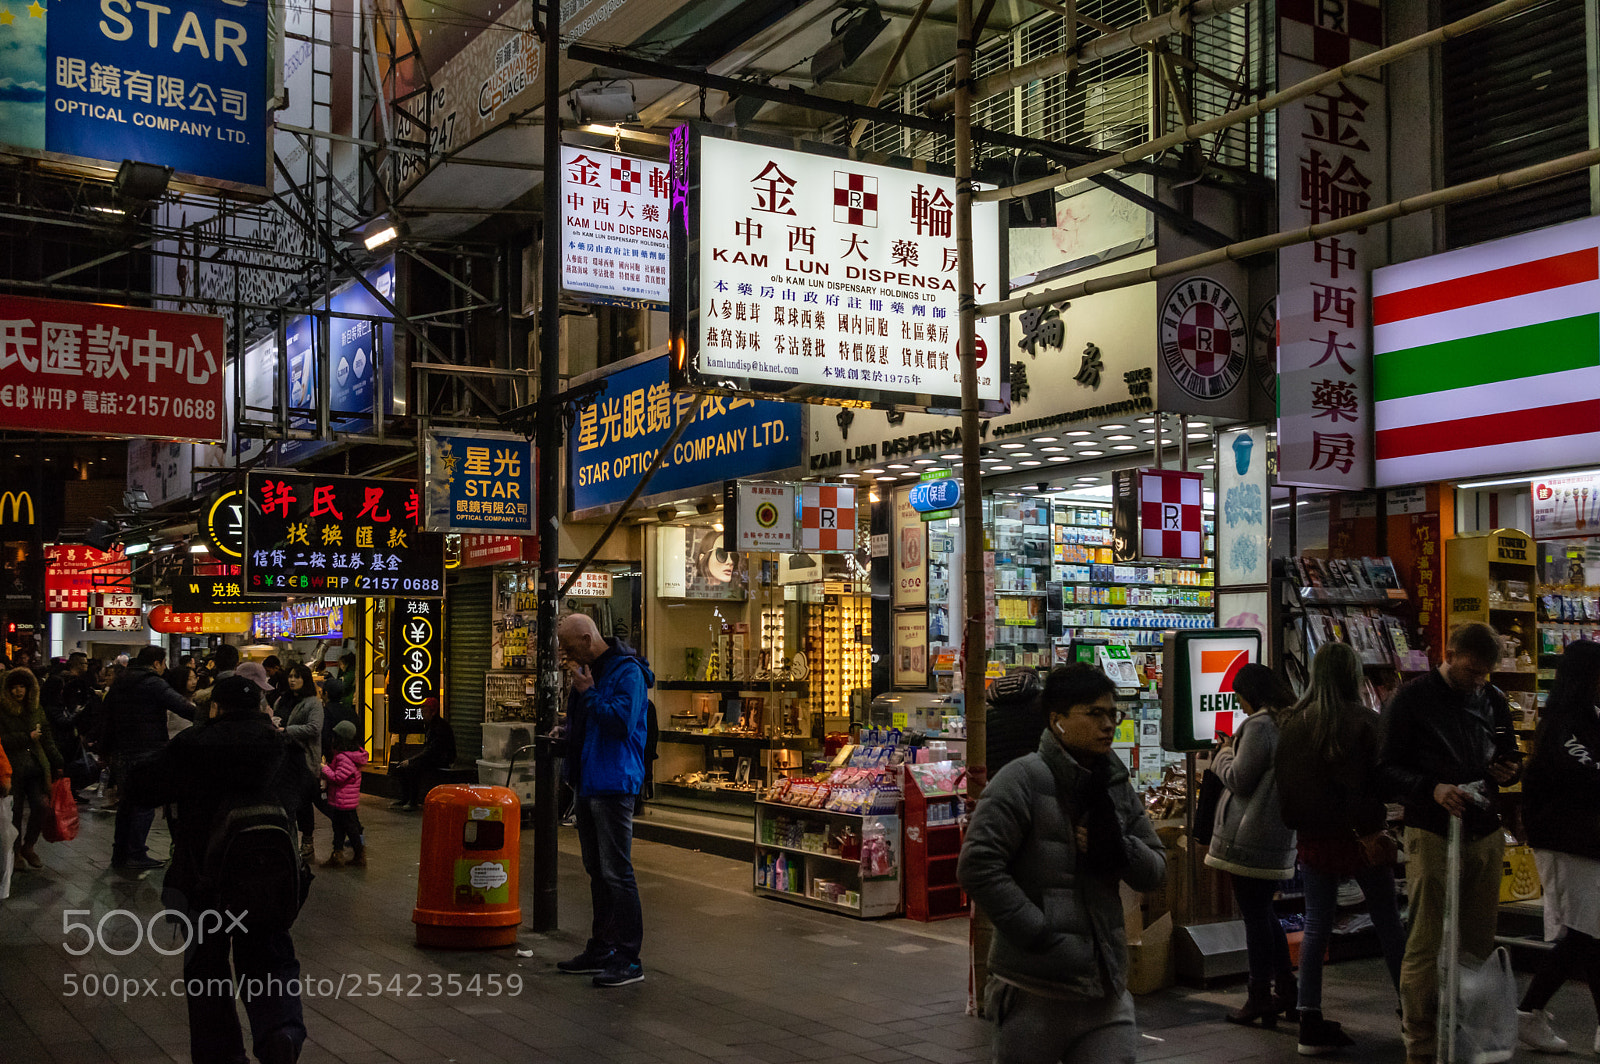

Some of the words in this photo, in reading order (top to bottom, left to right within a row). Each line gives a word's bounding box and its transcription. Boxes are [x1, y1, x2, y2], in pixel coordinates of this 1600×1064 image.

[99, 0, 248, 67] STAR
[55, 56, 248, 121] 眼鏡有限公司
[55, 98, 128, 123] OPTICAL
[132, 112, 212, 139] COMPANY
[217, 126, 250, 145] LTD.
[567, 192, 670, 224] 中西大藥
[567, 216, 590, 229] KAM
[594, 220, 615, 234] LUN
[607, 235, 639, 245] DISPENSARY
[712, 248, 768, 268] KAM
[785, 258, 829, 276] LUN
[846, 266, 987, 295] DISPENSAY
[771, 274, 783, 283] o/b
[786, 276, 806, 286] KAM
[808, 279, 825, 289] LUN
[827, 281, 878, 295] DISPENSARY
[880, 287, 919, 300] HOLDINGS
[922, 292, 936, 302] LTD
[707, 299, 761, 324] 人參鹿茸
[774, 305, 826, 331] 環球西藥
[838, 312, 889, 338] 國內同胞
[901, 320, 949, 344] 社區藥房
[0, 319, 218, 385] 氏匯款中心
[707, 327, 761, 352] 燕窩海味
[838, 340, 889, 366] 特價優惠
[707, 357, 799, 375] kamlundisp@hknet.com
[822, 366, 922, 386] 本號創業於1975年
[173, 397, 216, 420] 0688
[578, 461, 610, 487] STAR
[674, 427, 748, 465] COMPANY
[752, 420, 790, 449] LTD.
[811, 450, 842, 471] KAM
[847, 444, 877, 464] LUN
[882, 420, 990, 457] DISPENSAY
[464, 445, 521, 478] 星光
[465, 479, 521, 499] STAR
[456, 500, 528, 516] 眼鏡有限公司
[456, 514, 482, 522] OPTICAL
[484, 515, 508, 523] COMPANY
[287, 522, 408, 549] 找換匯款
[293, 553, 326, 570] 二按
[332, 552, 365, 569] 証券
[370, 553, 402, 571] 基金
[362, 576, 399, 590] 2157
[403, 577, 439, 591] 0688
[110, 595, 134, 607] 新昌
[407, 601, 430, 614] 兑换
[1200, 693, 1243, 712] ELEVE
